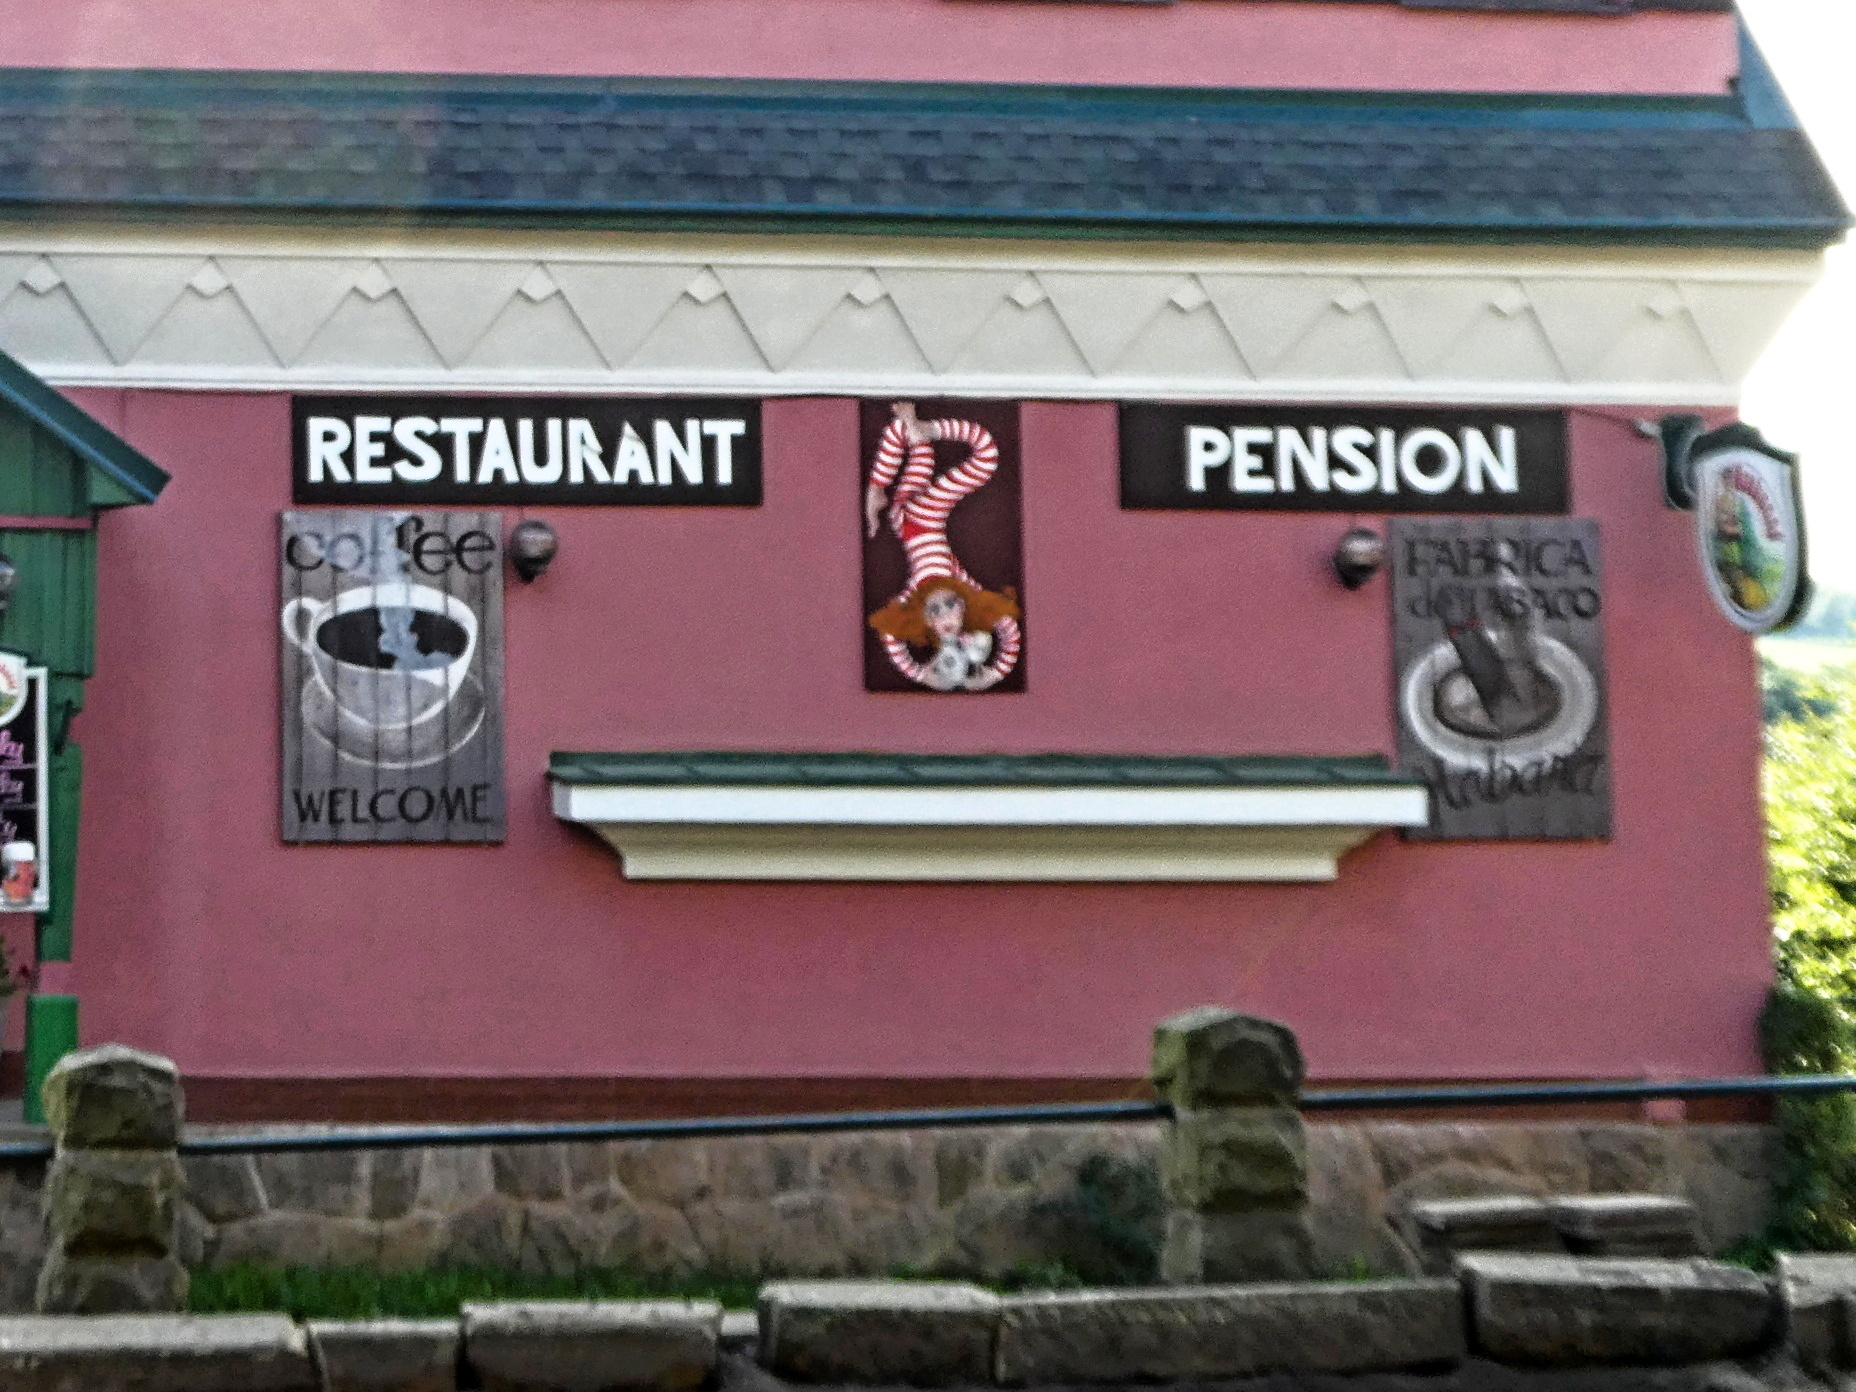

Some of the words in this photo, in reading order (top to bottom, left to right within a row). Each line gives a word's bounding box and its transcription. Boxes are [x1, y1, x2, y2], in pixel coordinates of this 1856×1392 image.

[306, 416, 746, 485] RESTAURANT
[1185, 424, 1519, 494] PENSION
[285, 515, 497, 576] coffee
[293, 782, 492, 825] WELCOME
